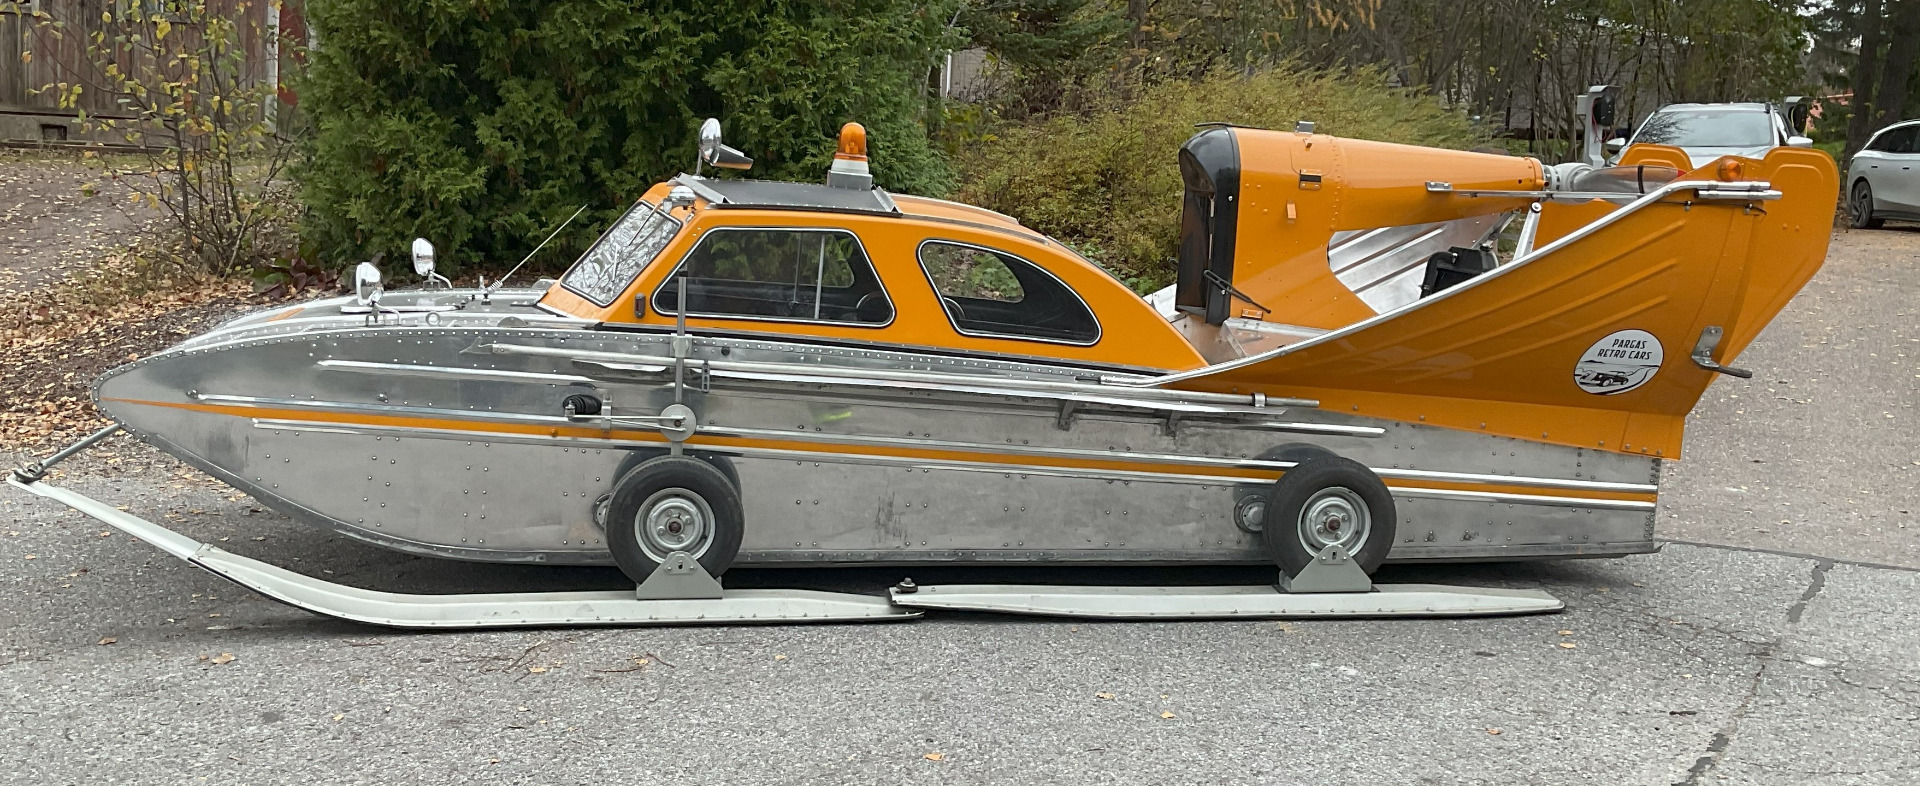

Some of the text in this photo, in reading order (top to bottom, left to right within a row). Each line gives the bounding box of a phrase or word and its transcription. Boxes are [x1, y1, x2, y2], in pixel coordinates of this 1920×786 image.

[1612, 339, 1648, 349] PARGAS
[1597, 349, 1652, 360] RETRO CARS
